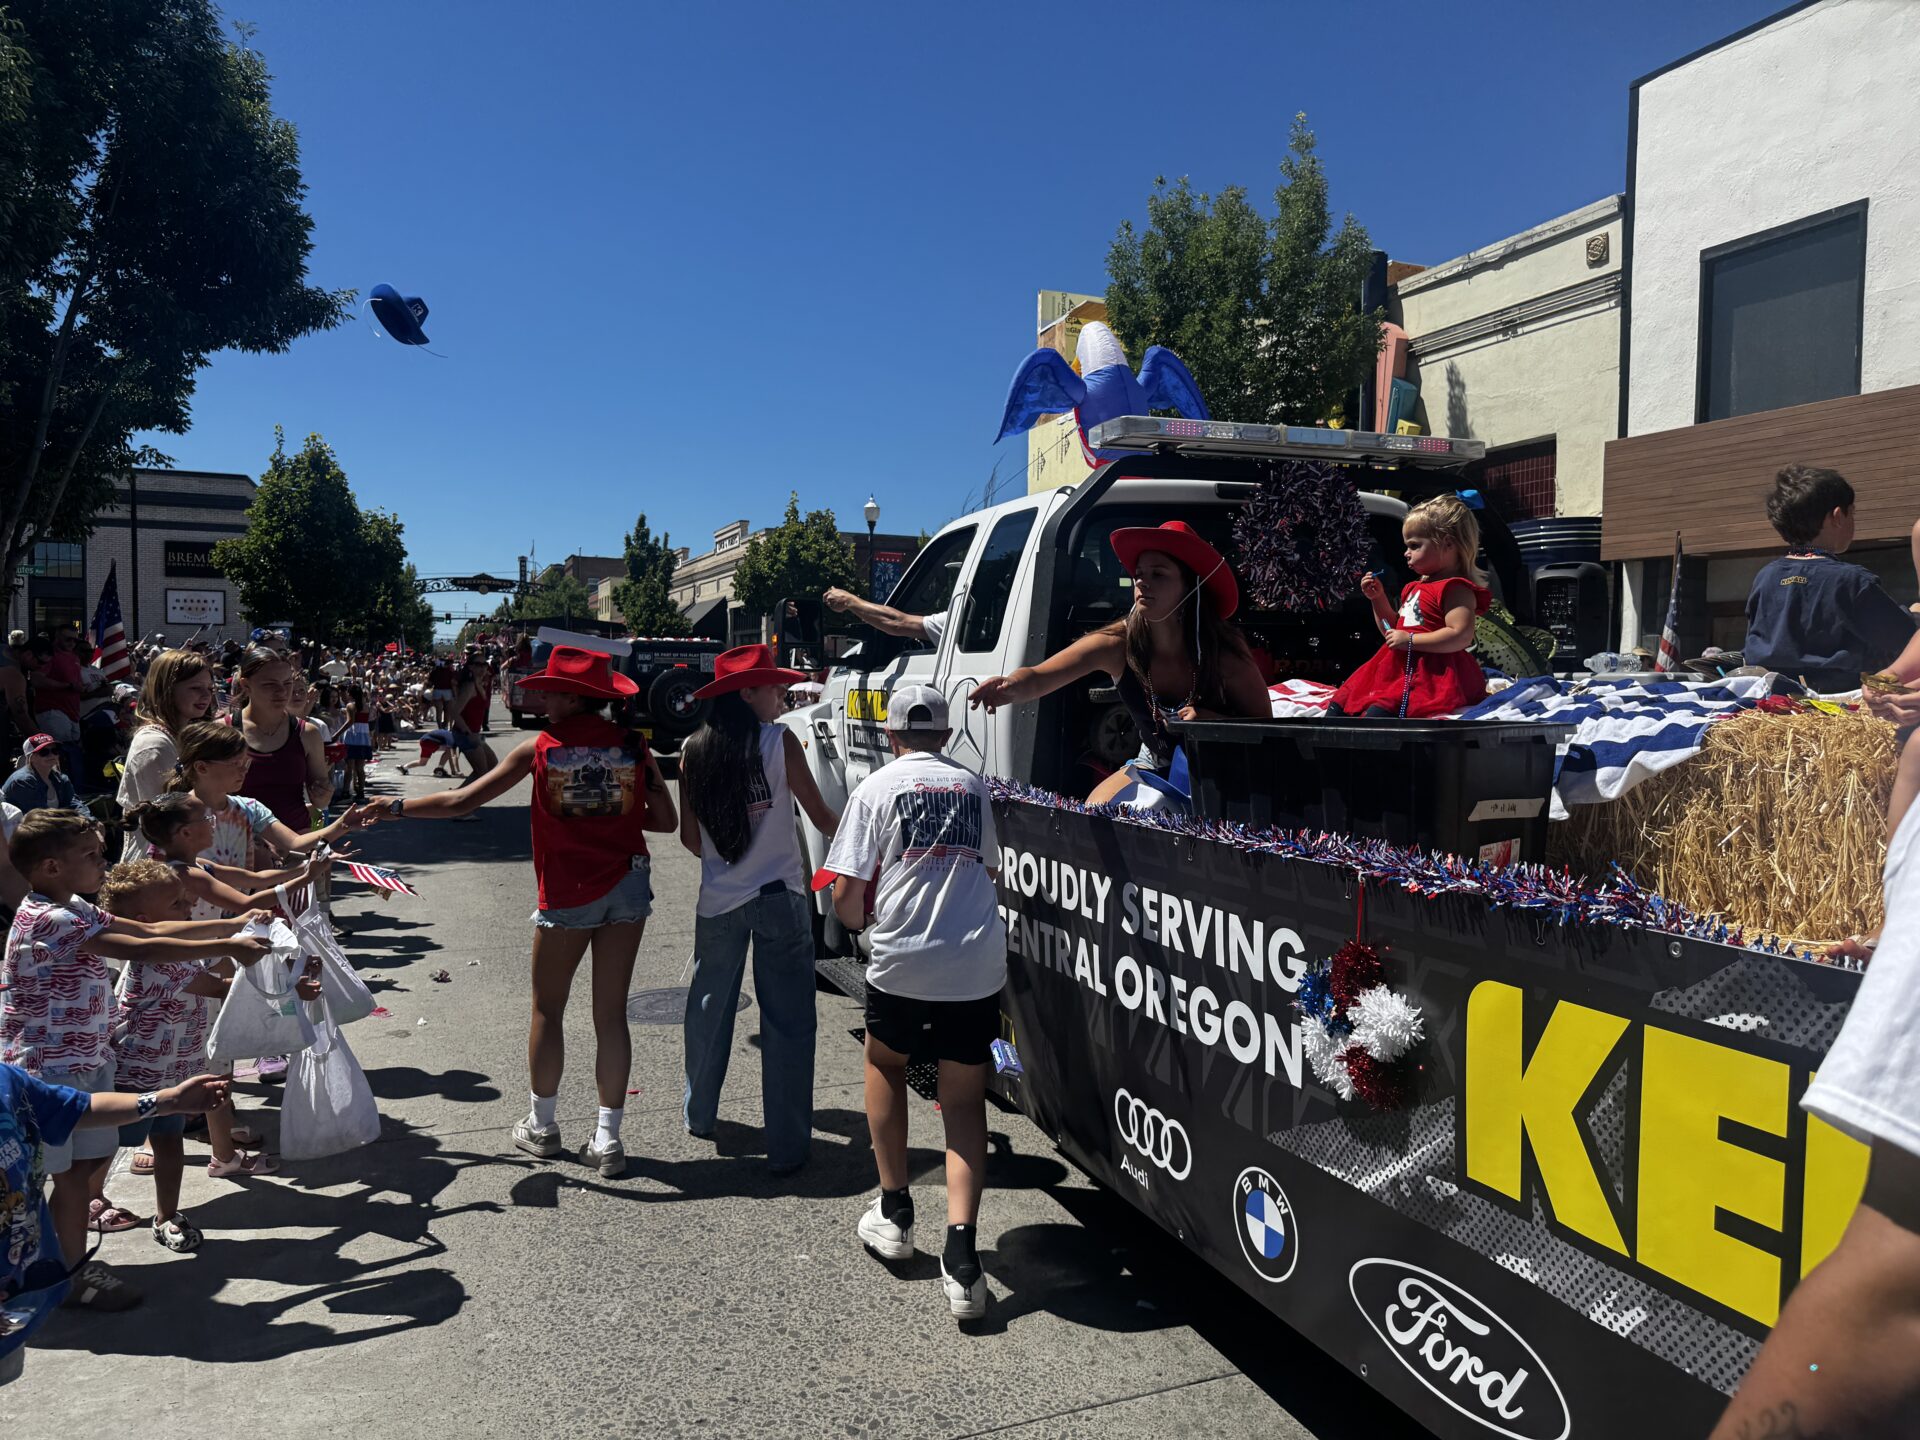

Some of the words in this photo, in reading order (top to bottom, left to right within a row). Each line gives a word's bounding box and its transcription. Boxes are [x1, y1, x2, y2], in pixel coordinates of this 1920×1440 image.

[914, 783, 950, 793] Driven
[952, 783, 967, 796] By
[1121, 881, 1307, 993] SERVING
[1114, 955, 1303, 1089] OREGON
[1120, 1154, 1149, 1190] Audi
[1241, 1173, 1289, 1215] BMW
[1385, 1277, 1529, 1420] Ford
